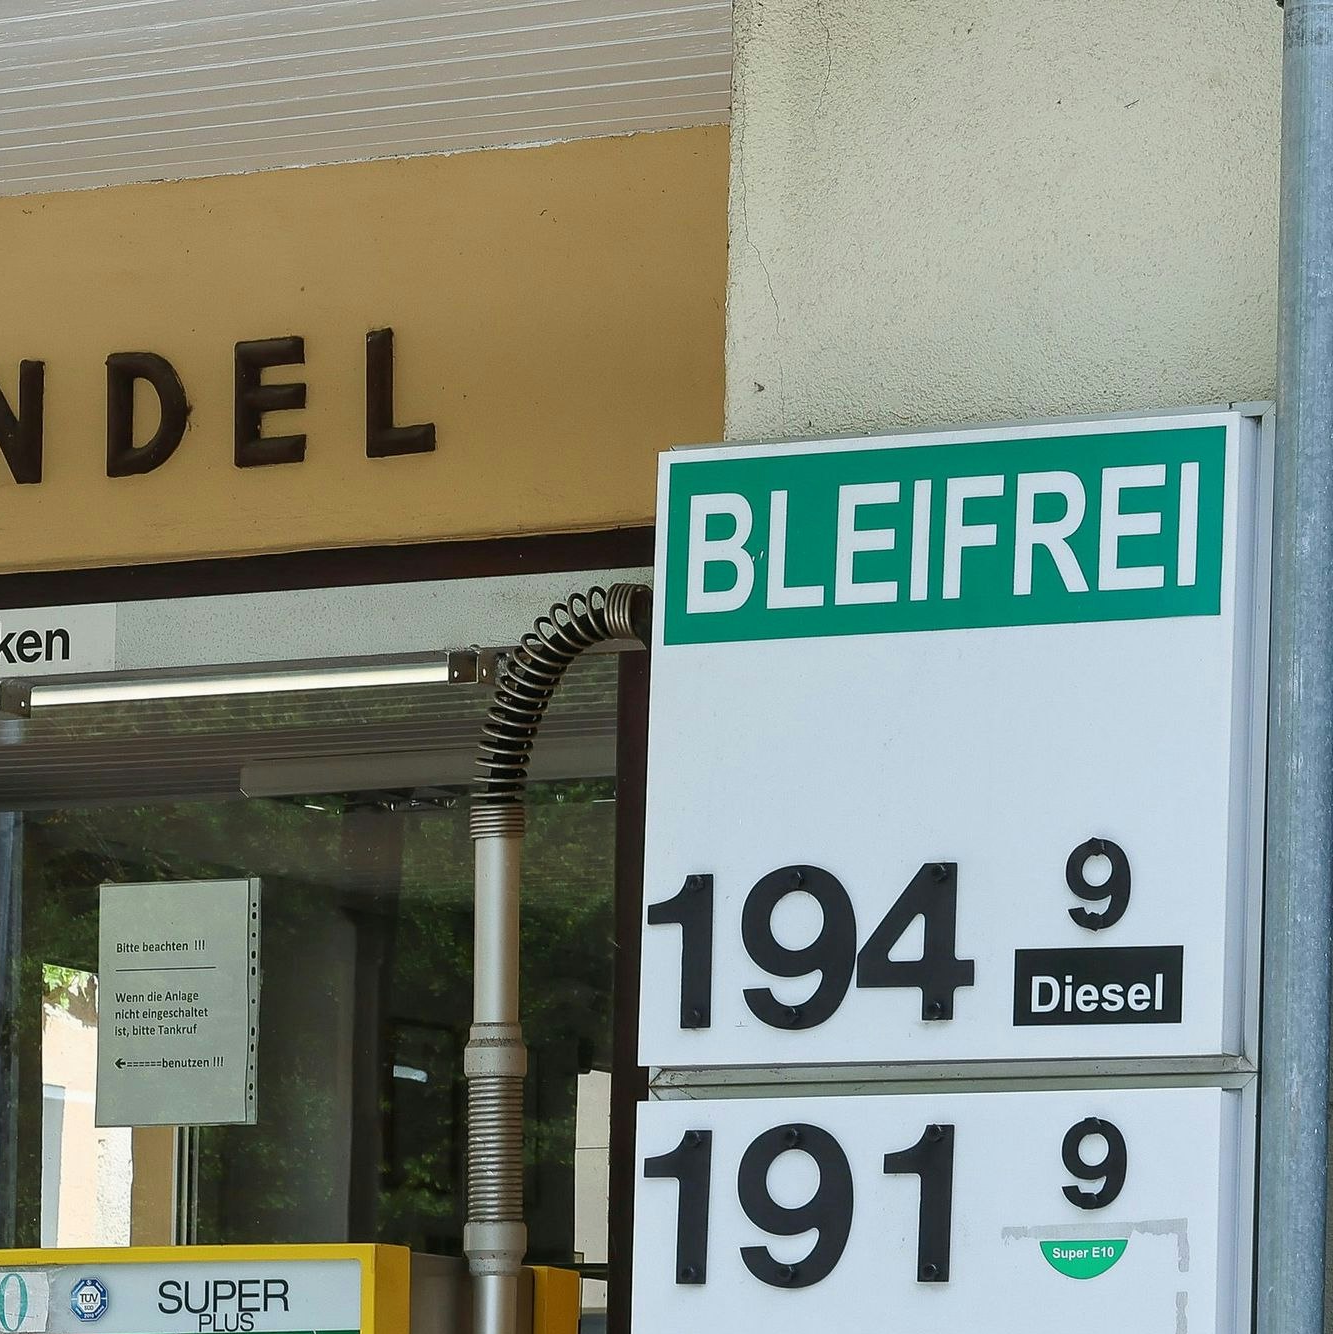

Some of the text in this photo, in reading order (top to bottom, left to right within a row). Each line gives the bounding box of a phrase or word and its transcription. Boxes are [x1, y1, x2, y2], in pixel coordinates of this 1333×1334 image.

[685, 462, 1201, 615] BLEIFREI
[647, 837, 1132, 1031] 194 9
[116, 940, 205, 953] Bitte beachten !!!
[115, 990, 199, 1003] Wenn die Anlage
[1031, 973, 1165, 1013] Diesel
[115, 1007, 209, 1020] nicht eingeschaltet
[115, 1023, 197, 1038] ist, bitte Tankruf
[213, 1057, 224, 1068] !!!
[643, 1116, 1128, 1290] 191 9
[1052, 1246, 1115, 1261] Super E10
[158, 1279, 290, 1315] SUPER
[198, 1313, 255, 1333] PLUS
